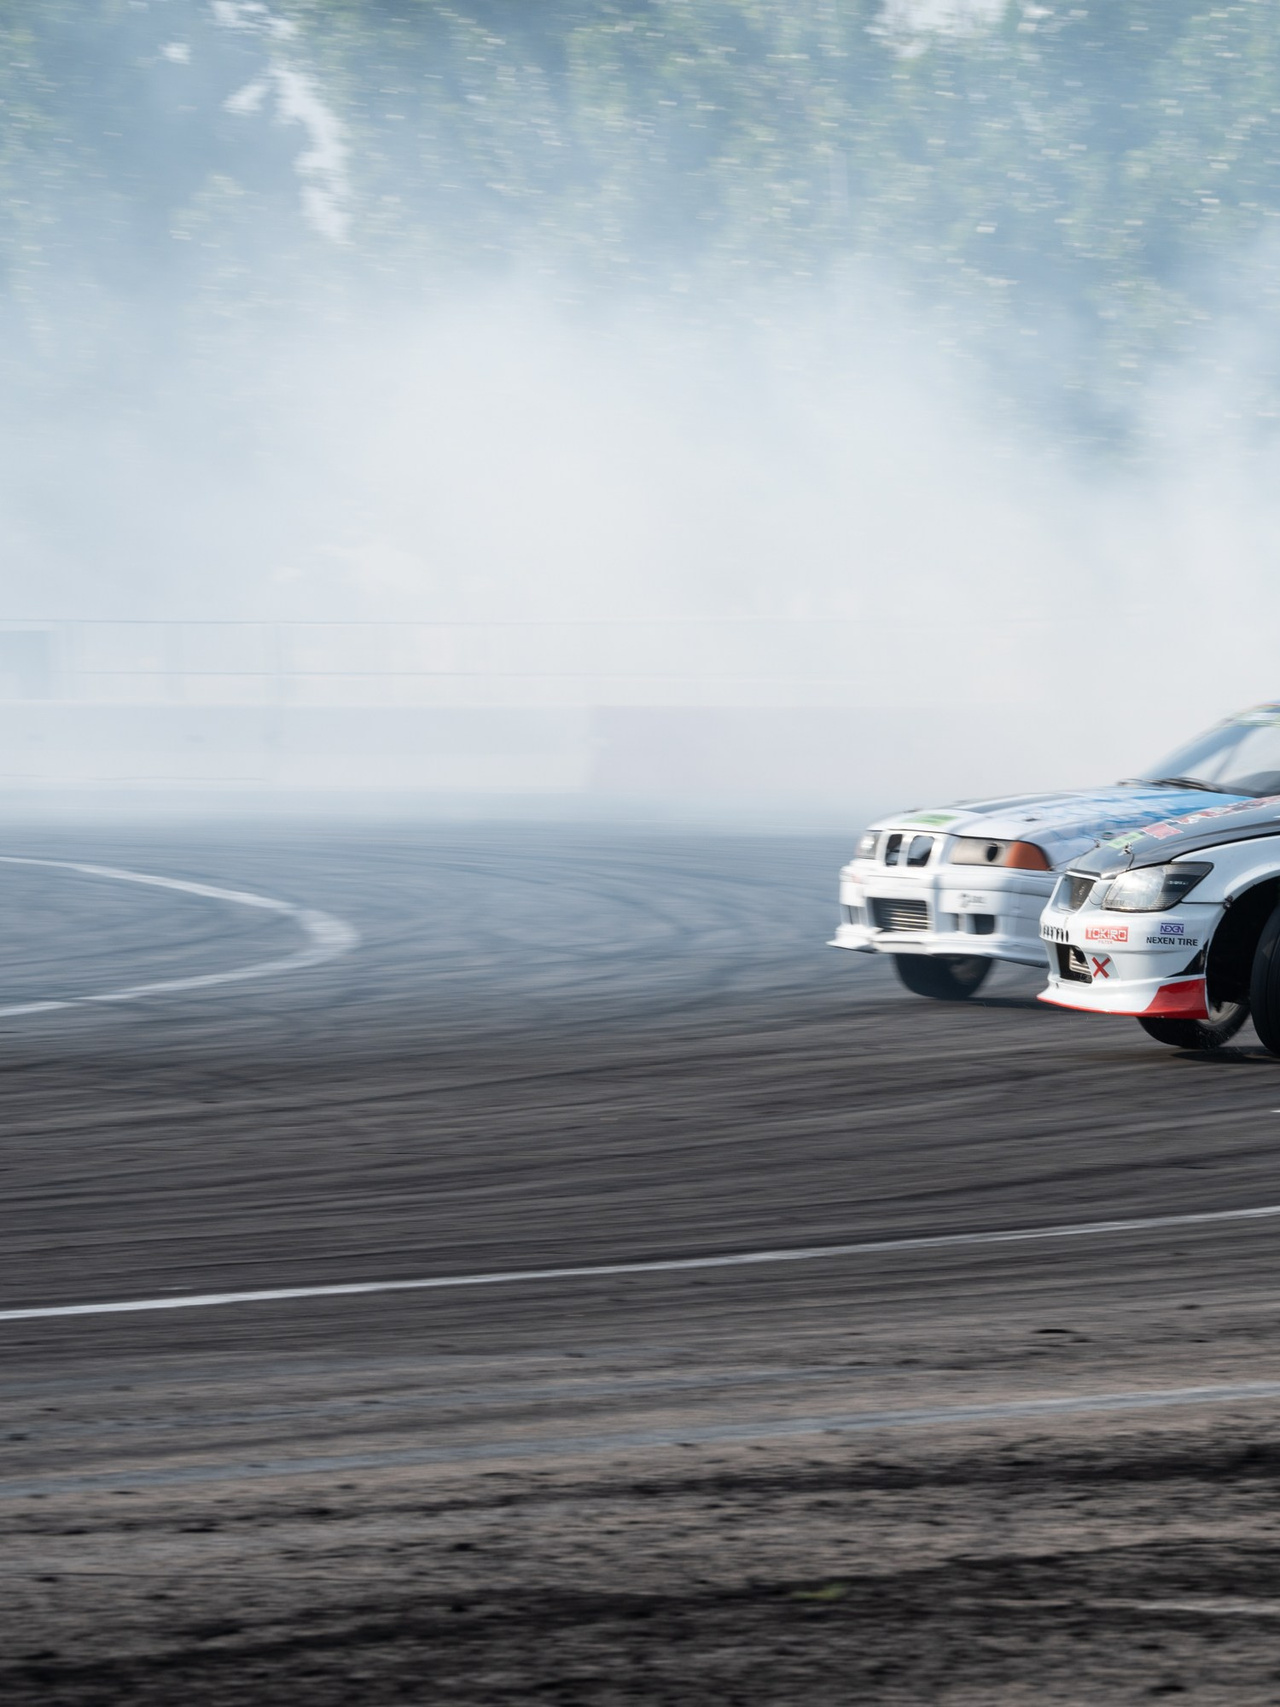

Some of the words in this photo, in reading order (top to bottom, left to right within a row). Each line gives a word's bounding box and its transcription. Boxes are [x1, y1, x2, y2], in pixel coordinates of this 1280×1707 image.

[1086, 926, 1128, 942] TOKIRO
[1159, 923, 1185, 935] NEXEN
[1146, 936, 1175, 946] NEXEN
[1178, 937, 1199, 947] TIRE
